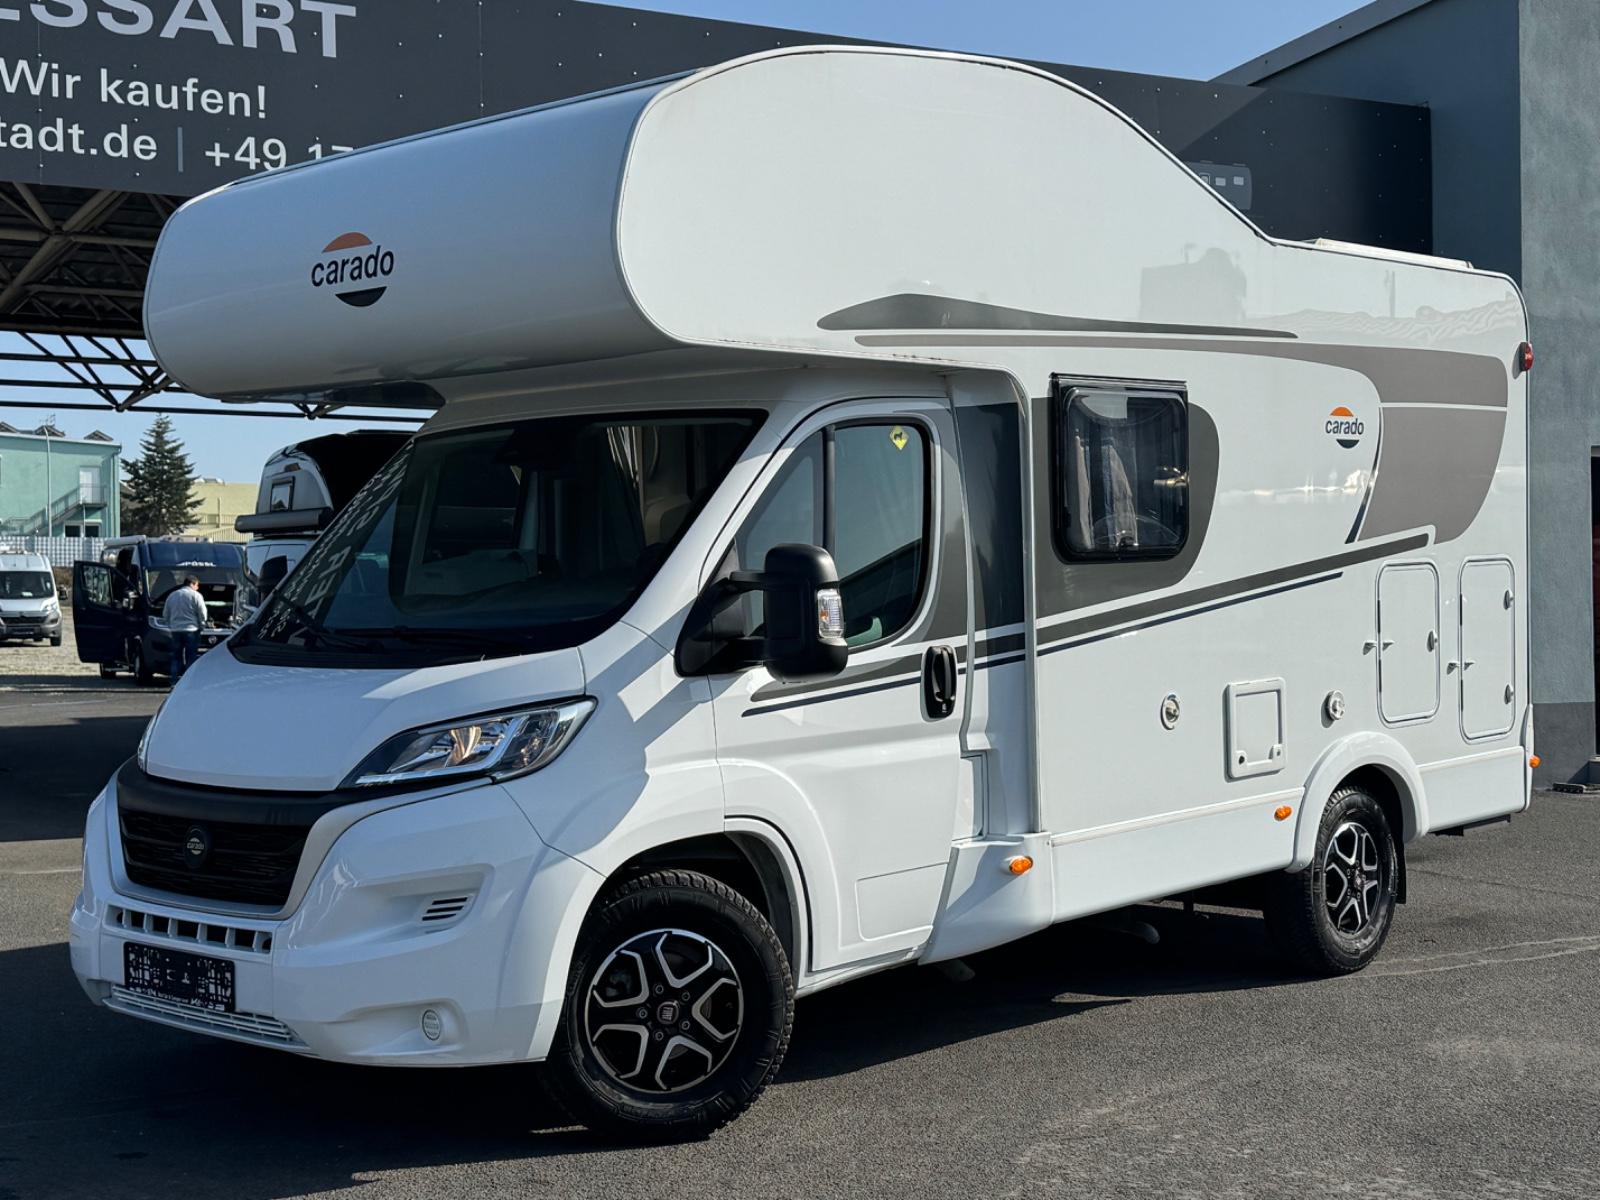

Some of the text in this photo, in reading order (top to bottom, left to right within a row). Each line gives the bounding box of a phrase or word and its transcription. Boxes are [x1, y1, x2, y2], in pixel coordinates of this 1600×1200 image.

[0, 57, 266, 119] Wir kaufen!
[204, 136, 287, 171] +49
[311, 244, 395, 287] carado
[1325, 417, 1365, 435] carado
